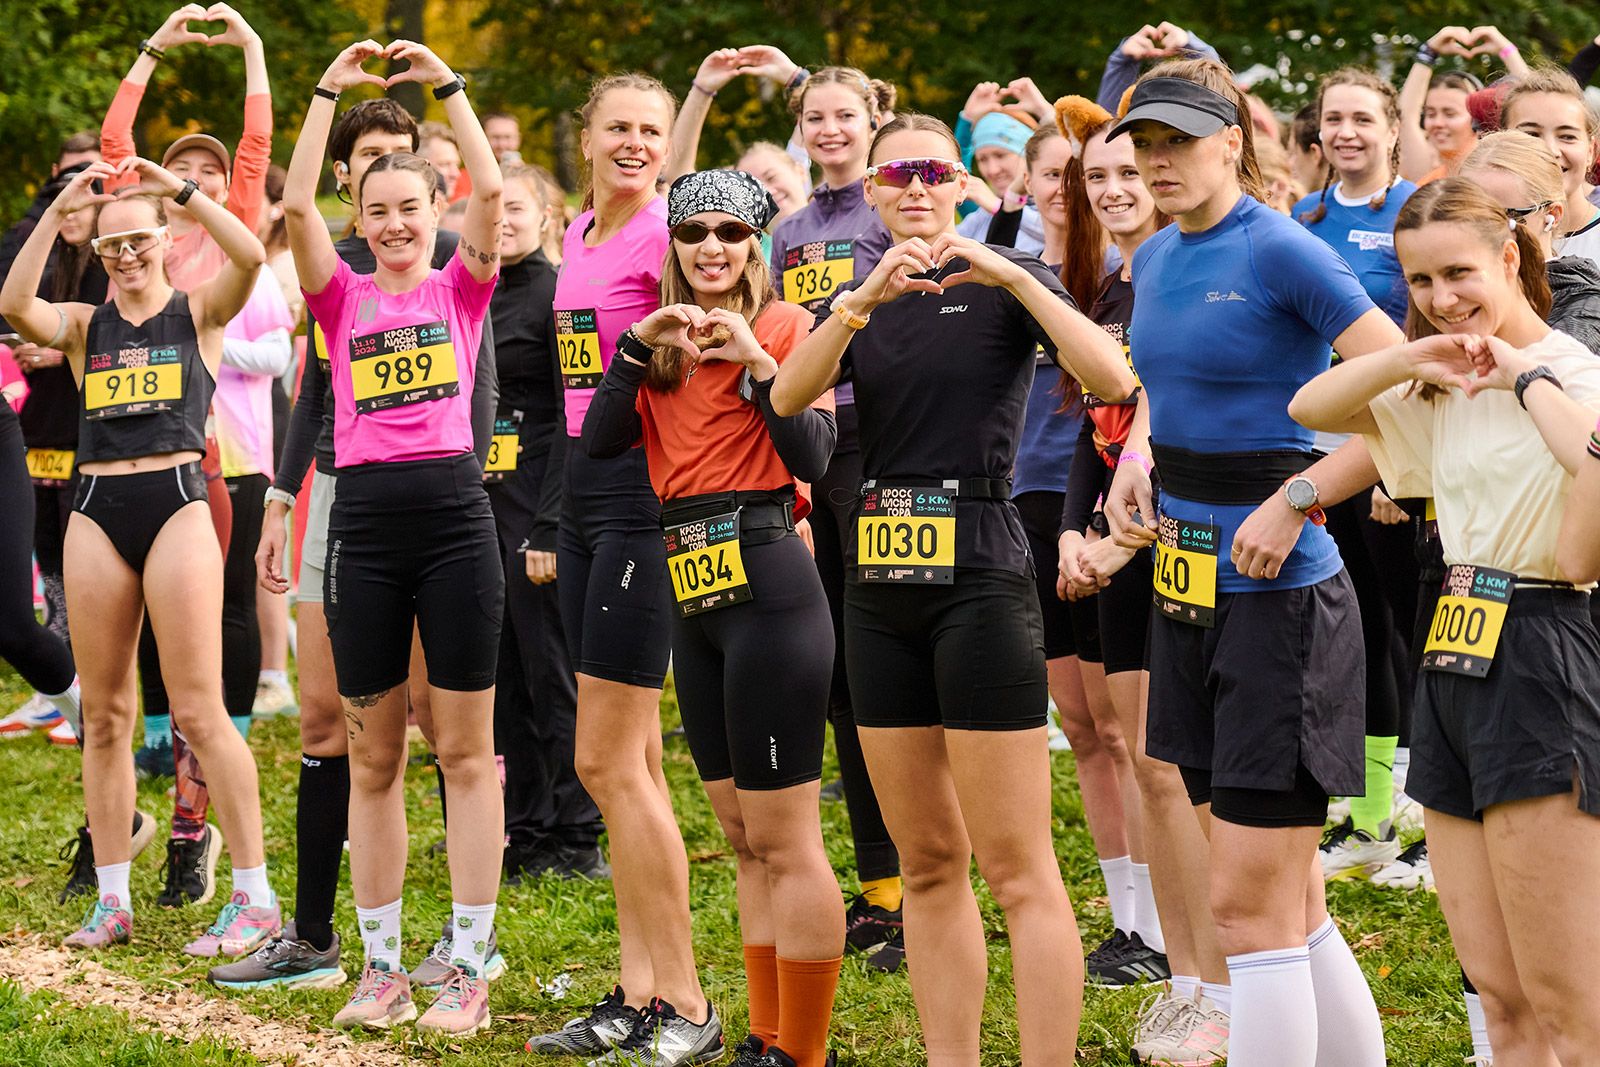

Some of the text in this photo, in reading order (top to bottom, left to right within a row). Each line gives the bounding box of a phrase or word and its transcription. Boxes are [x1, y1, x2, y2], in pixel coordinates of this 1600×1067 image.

[796, 266, 832, 298] 936
[939, 305, 968, 314] SONU
[574, 315, 579, 323] 6
[384, 327, 416, 340] КРОСС
[420, 329, 428, 337] 6
[384, 335, 418, 348] ЛИСЬЯ
[354, 346, 376, 356] 2026
[394, 344, 418, 352] ГОРА
[560, 338, 592, 368] 026
[374, 353, 432, 389] 989
[106, 372, 158, 400] 918
[882, 488, 912, 498] КРОСС
[916, 494, 926, 504] 6
[880, 498, 912, 508] ЛИСЬЯ
[888, 508, 912, 516] ГОРА
[680, 522, 706, 536] КРОСС
[708, 524, 716, 534] 6
[1182, 526, 1190, 538] 6
[680, 531, 706, 546] ЛИСЬЯ
[866, 523, 938, 558] 1030
[688, 540, 708, 552] ГОРА
[675, 549, 732, 594] 1034
[1476, 573, 1484, 585] 6
